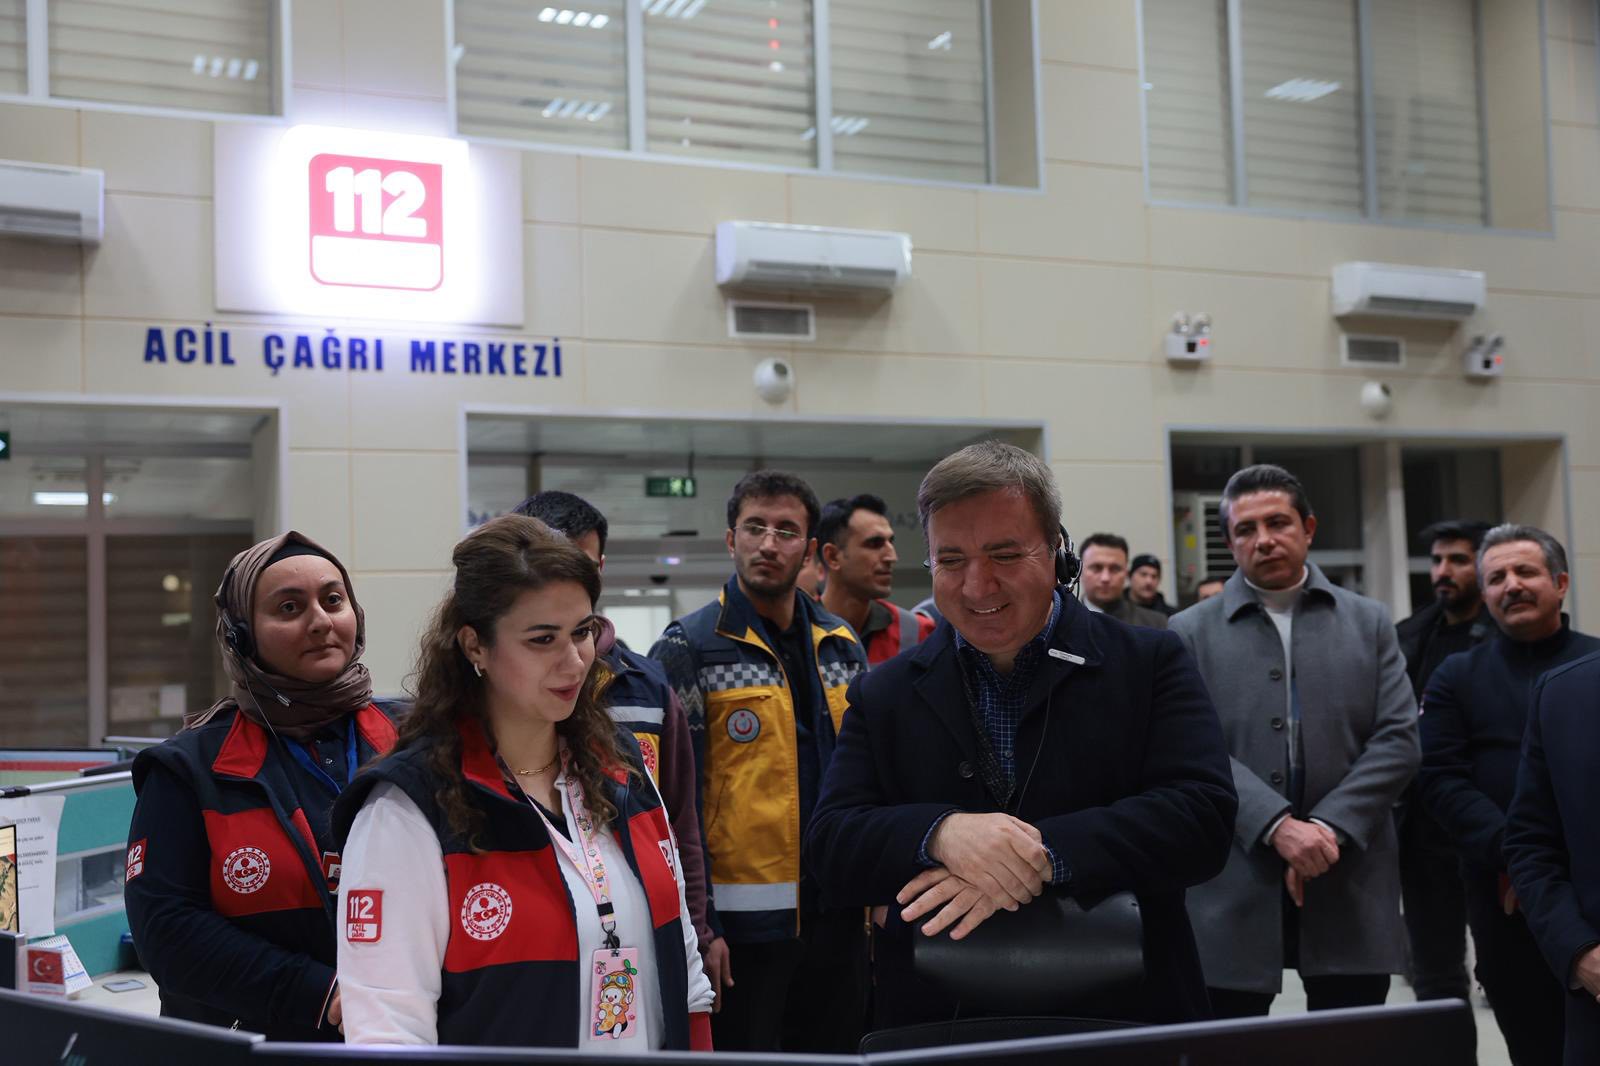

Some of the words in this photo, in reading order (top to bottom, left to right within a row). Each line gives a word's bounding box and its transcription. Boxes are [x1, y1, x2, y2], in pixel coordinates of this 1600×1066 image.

[326, 166, 427, 238] 112
[143, 321, 236, 366] ACİL
[263, 328, 383, 376] ÇAĞRI
[410, 337, 562, 378] MERKEZİ
[128, 845, 142, 867] 112
[350, 896, 375, 919] 112
